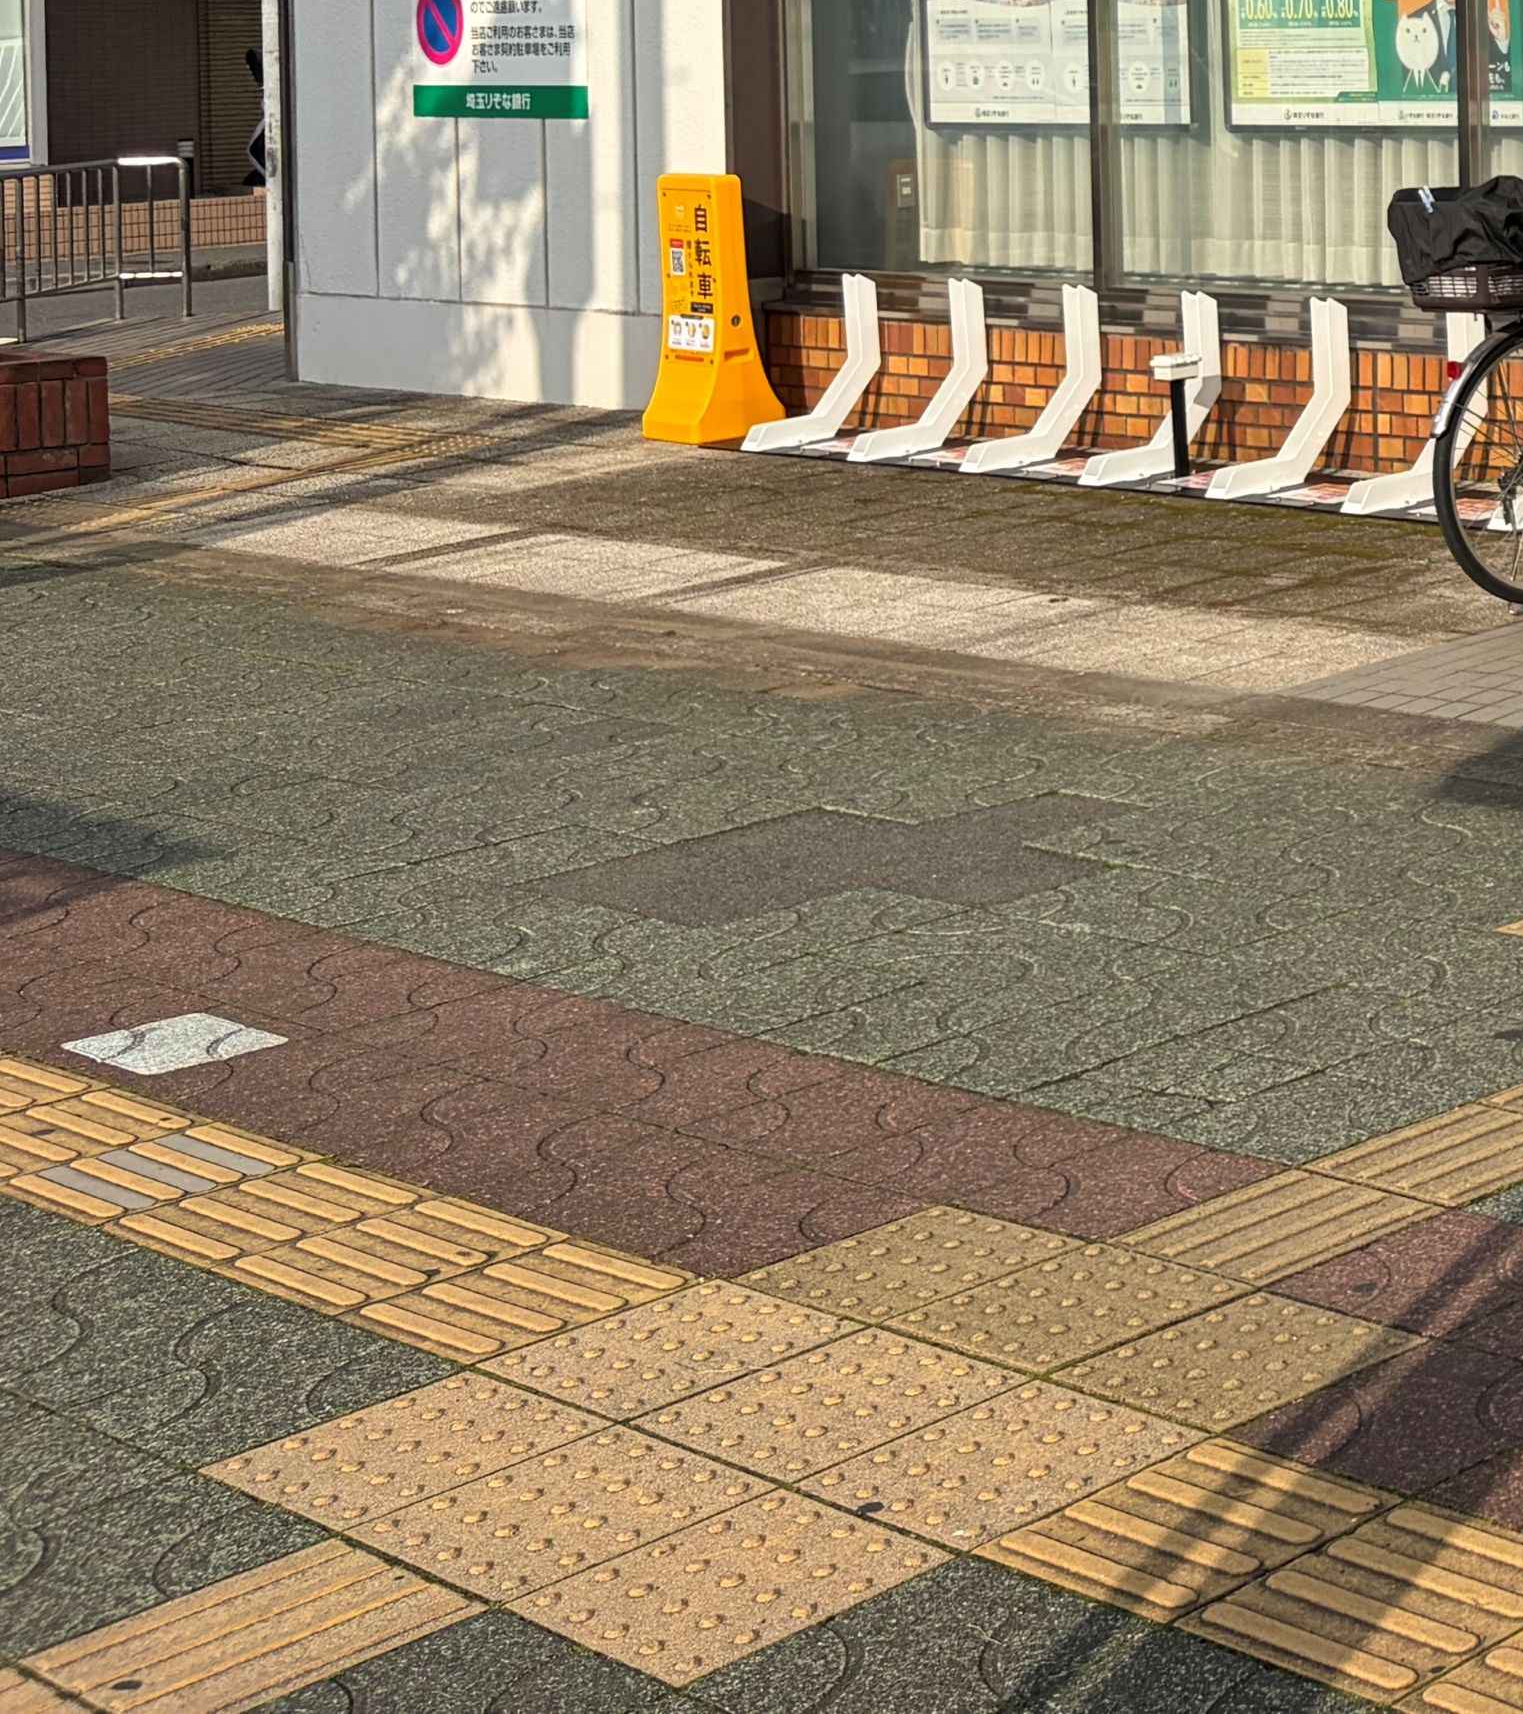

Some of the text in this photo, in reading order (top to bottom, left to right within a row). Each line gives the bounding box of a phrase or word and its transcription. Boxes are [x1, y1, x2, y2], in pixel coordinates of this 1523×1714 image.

[472, 60, 499, 73] 下さい。
[466, 92, 531, 110] 埼玉りそな銀行
[694, 204, 714, 300] 自転車
